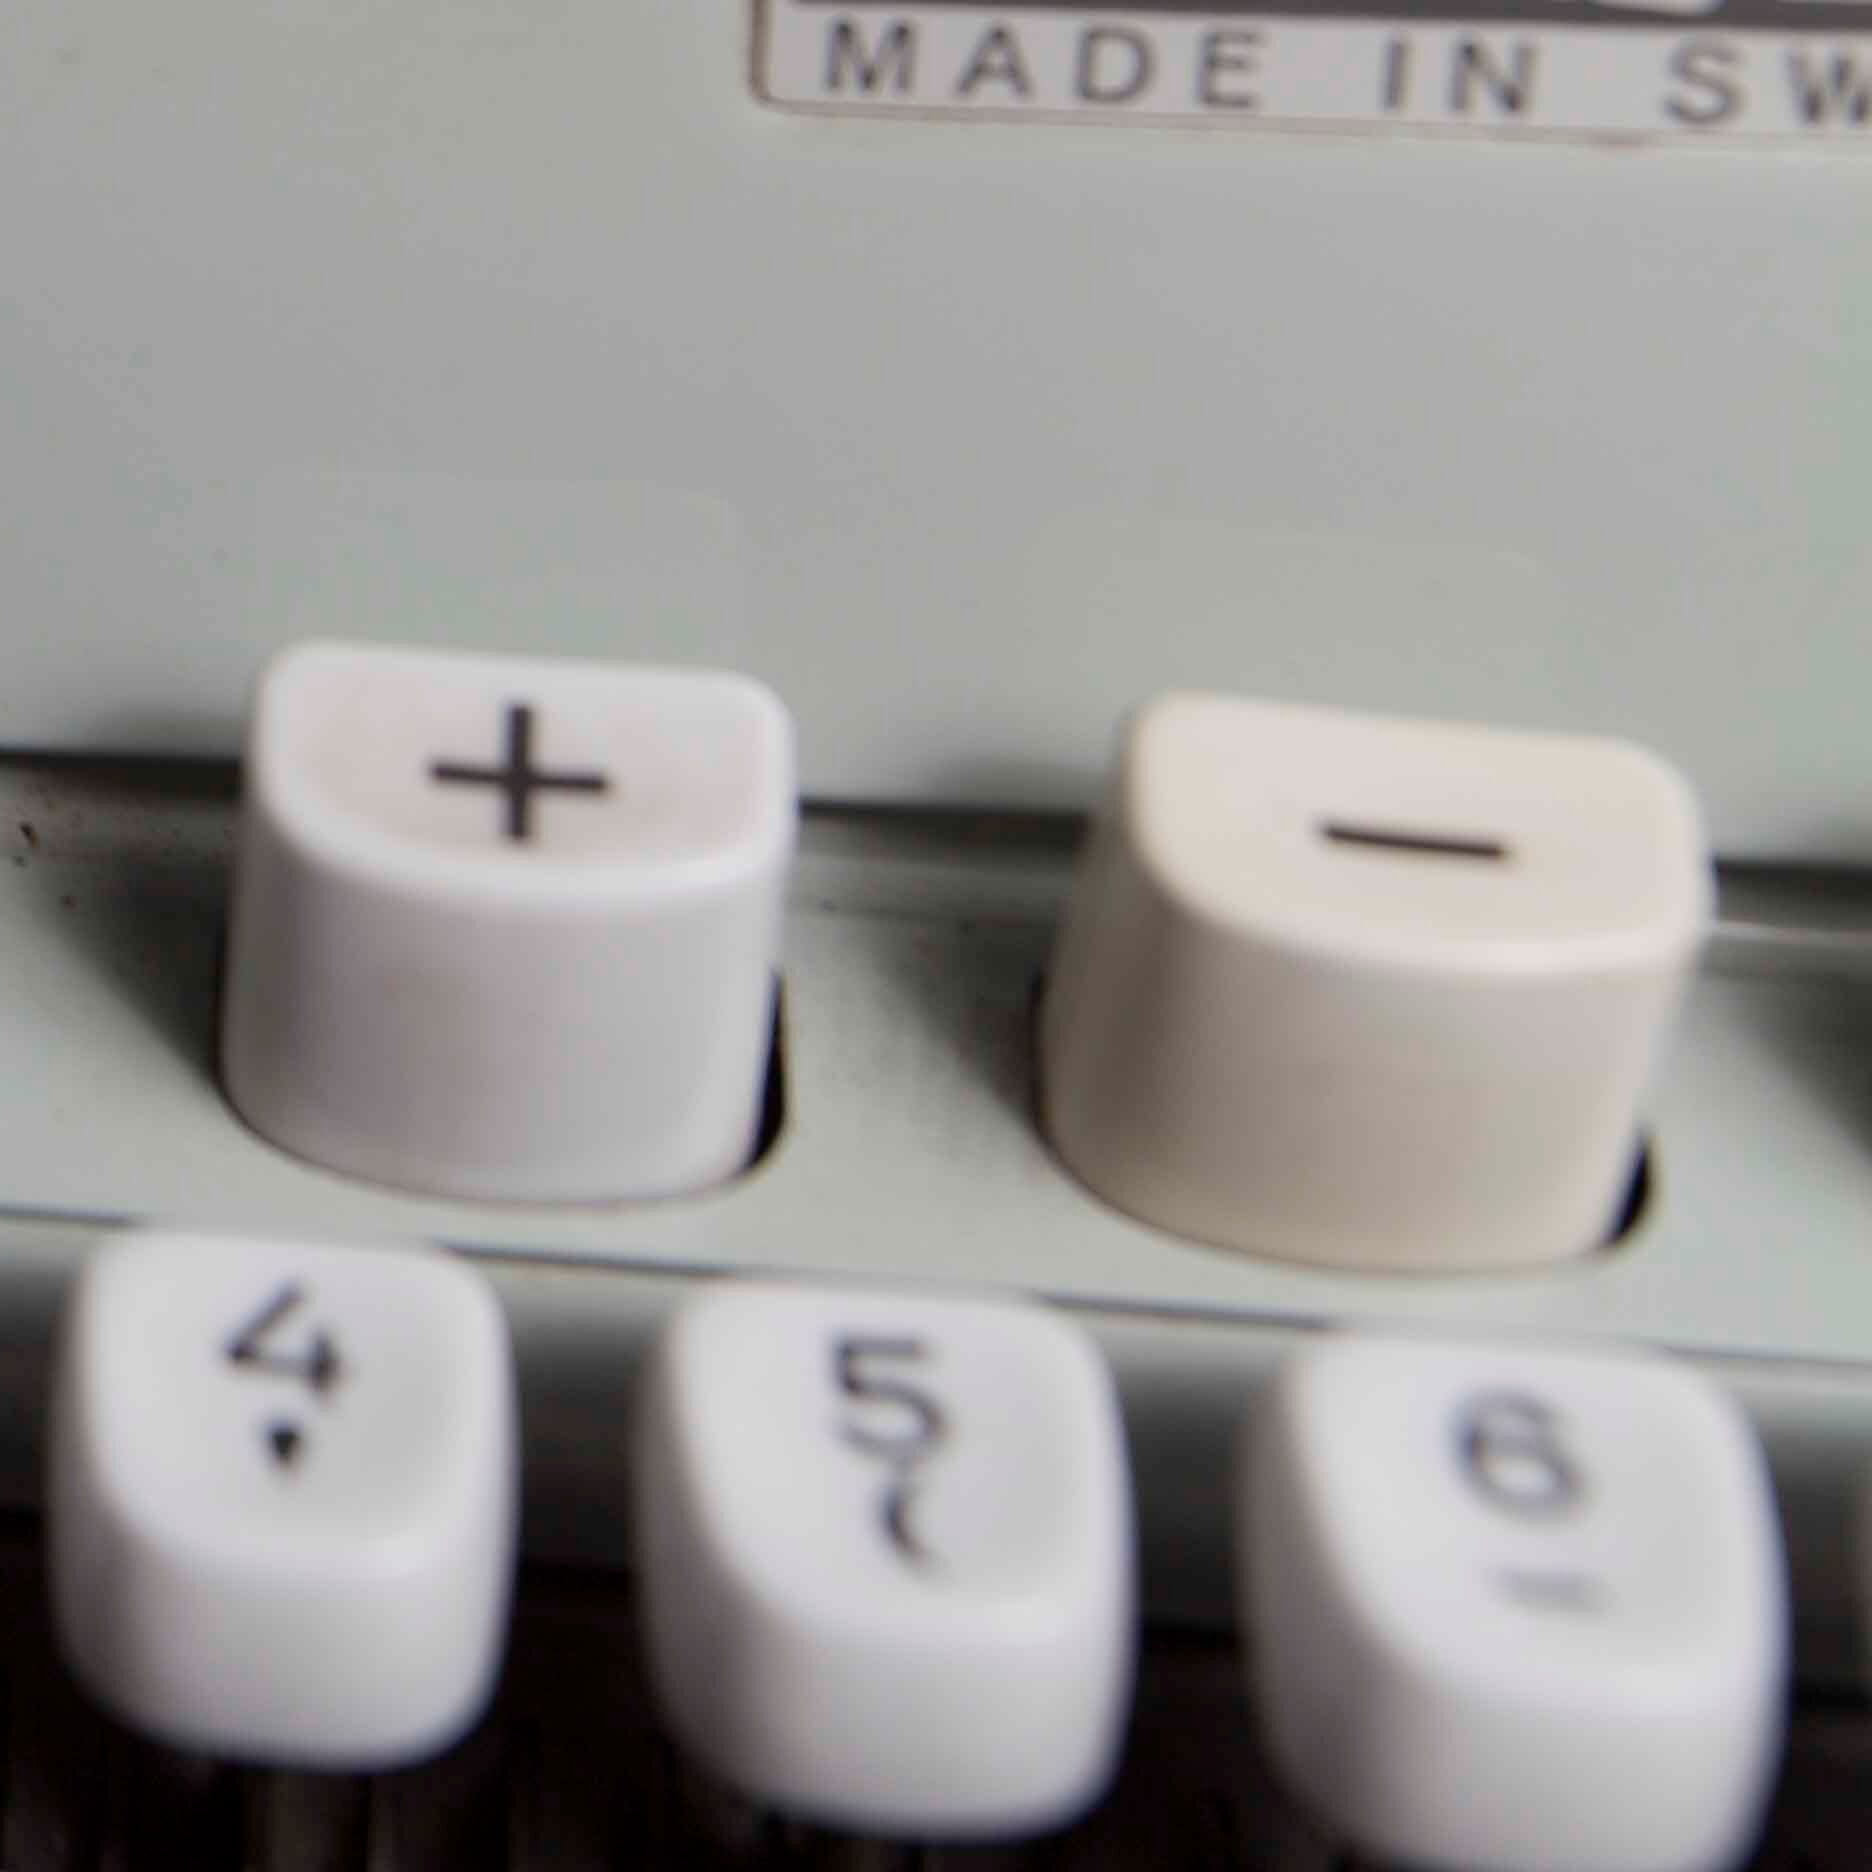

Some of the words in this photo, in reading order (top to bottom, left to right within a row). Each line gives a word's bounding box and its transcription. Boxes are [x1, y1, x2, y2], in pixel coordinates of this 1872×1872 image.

[824, 18, 1262, 109] MADE
[1383, 38, 1535, 117] IN
[427, 702, 611, 844] +
[224, 1278, 346, 1400] 4
[832, 1332, 948, 1466] 5
[1450, 1386, 1588, 1528] 6
